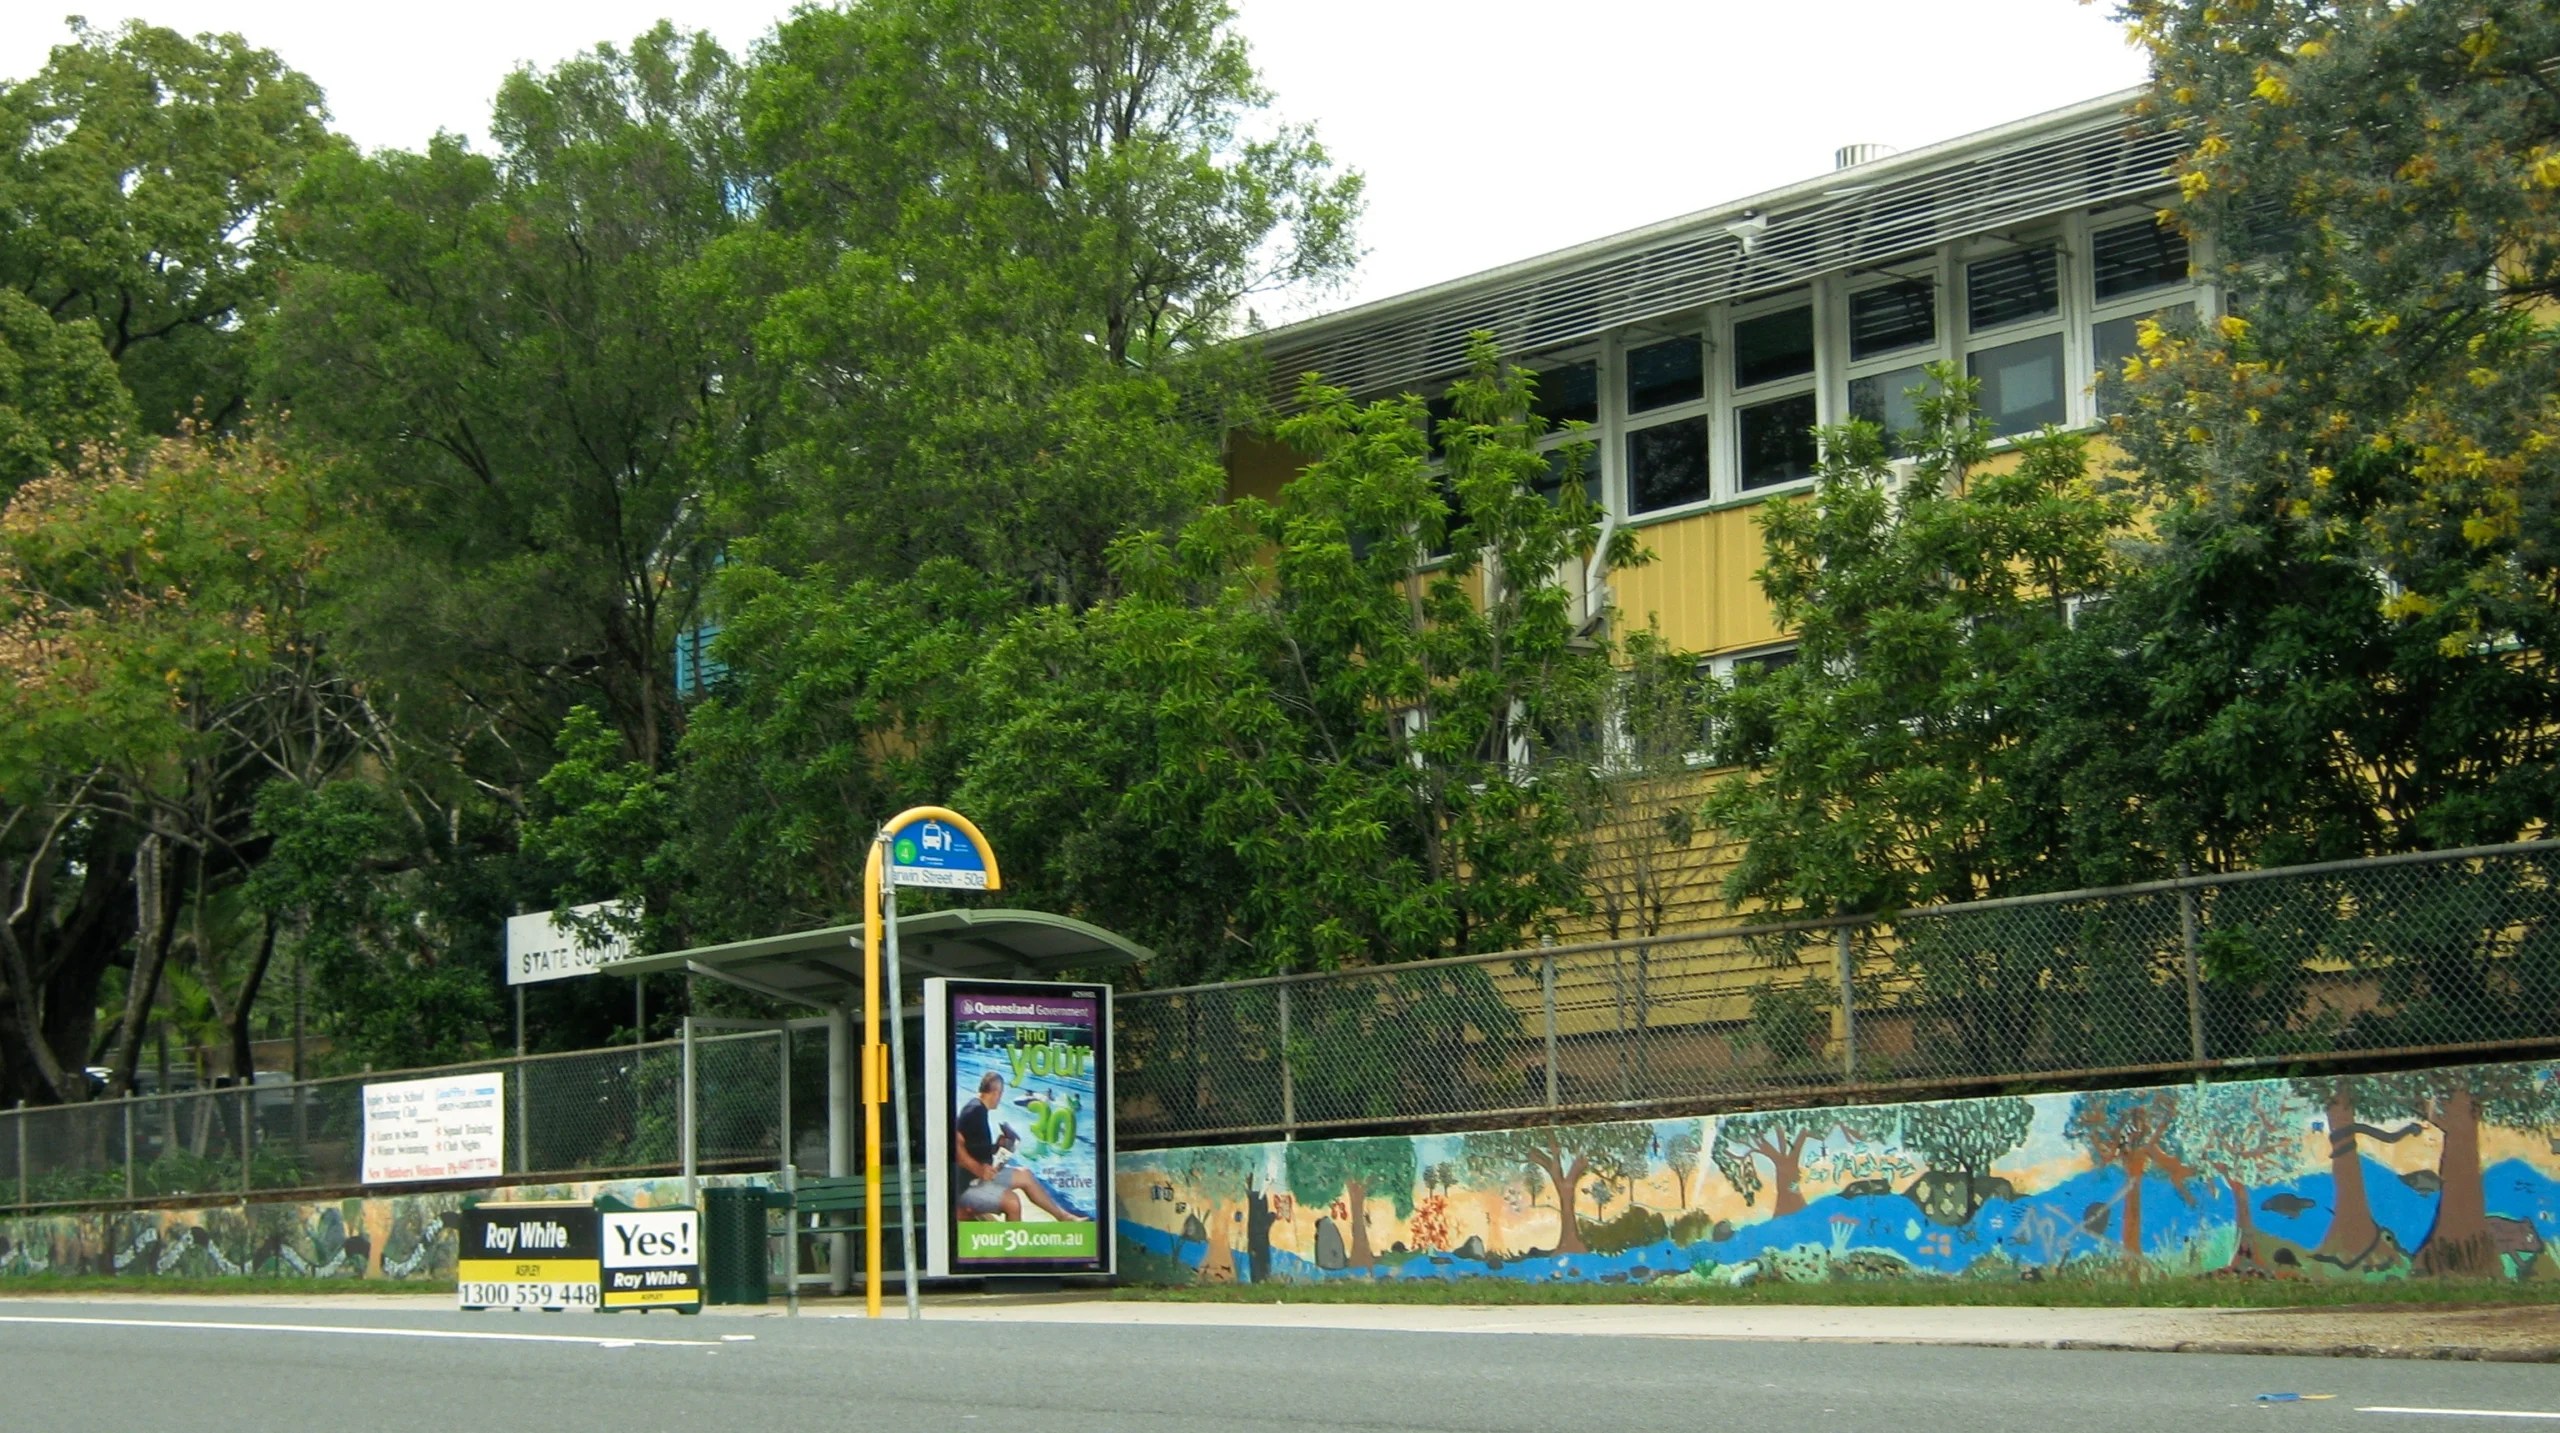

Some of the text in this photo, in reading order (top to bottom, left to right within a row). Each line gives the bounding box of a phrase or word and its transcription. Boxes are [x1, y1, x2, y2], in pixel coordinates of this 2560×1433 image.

[901, 847, 909, 858] 4
[922, 869, 953, 885] Street
[523, 948, 568, 974] STATE
[974, 1002, 1089, 1018] Queensland Government
[1015, 1025, 1047, 1042] Find
[1006, 1044, 1091, 1088] your
[1027, 1100, 1077, 1150] 30
[1058, 1174, 1093, 1188] active
[485, 1221, 568, 1253] Ray White
[614, 1222, 690, 1256] Yes!
[971, 1230, 1084, 1251] your30.com.au
[613, 1271, 688, 1289] Ray White
[462, 1284, 598, 1305] 1300 559 448
